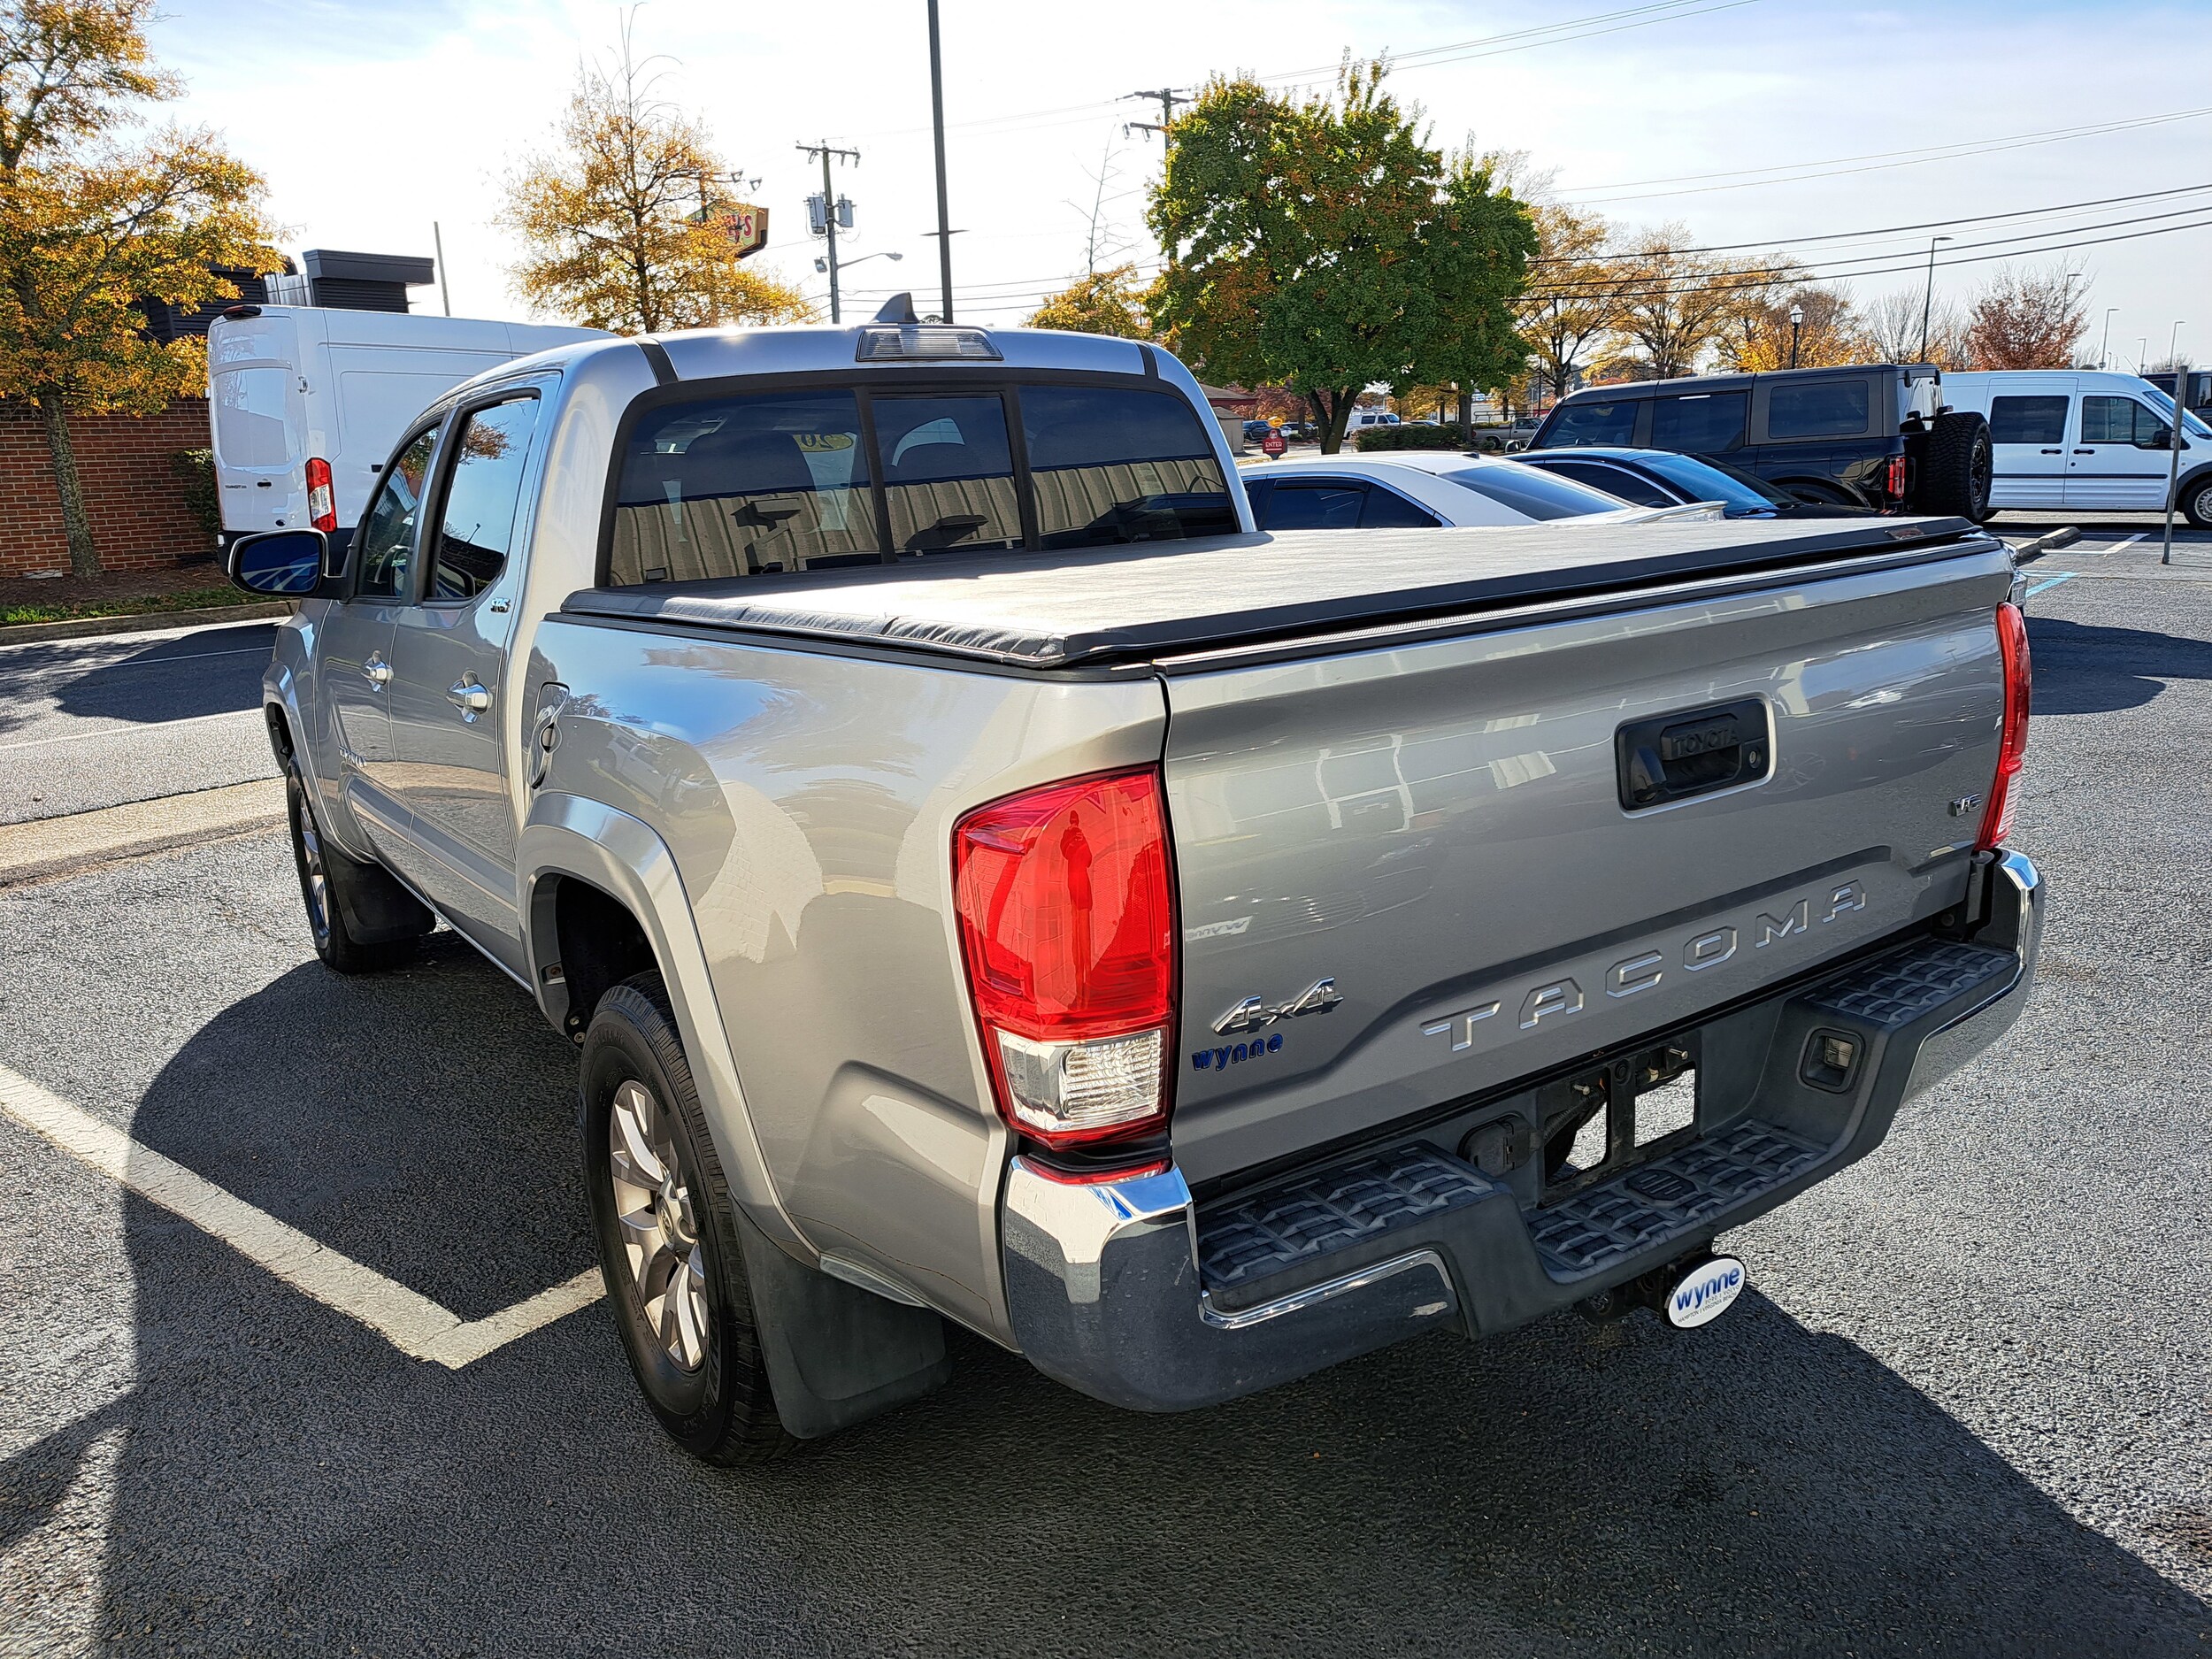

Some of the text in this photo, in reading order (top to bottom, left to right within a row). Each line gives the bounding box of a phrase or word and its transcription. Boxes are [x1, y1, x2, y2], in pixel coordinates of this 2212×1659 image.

[1672, 726, 1740, 756] TOYOTA
[1419, 879, 1867, 1051] TACOMA
[1192, 1033, 1284, 1071] wynne
[1676, 1267, 1740, 1311] wynne
